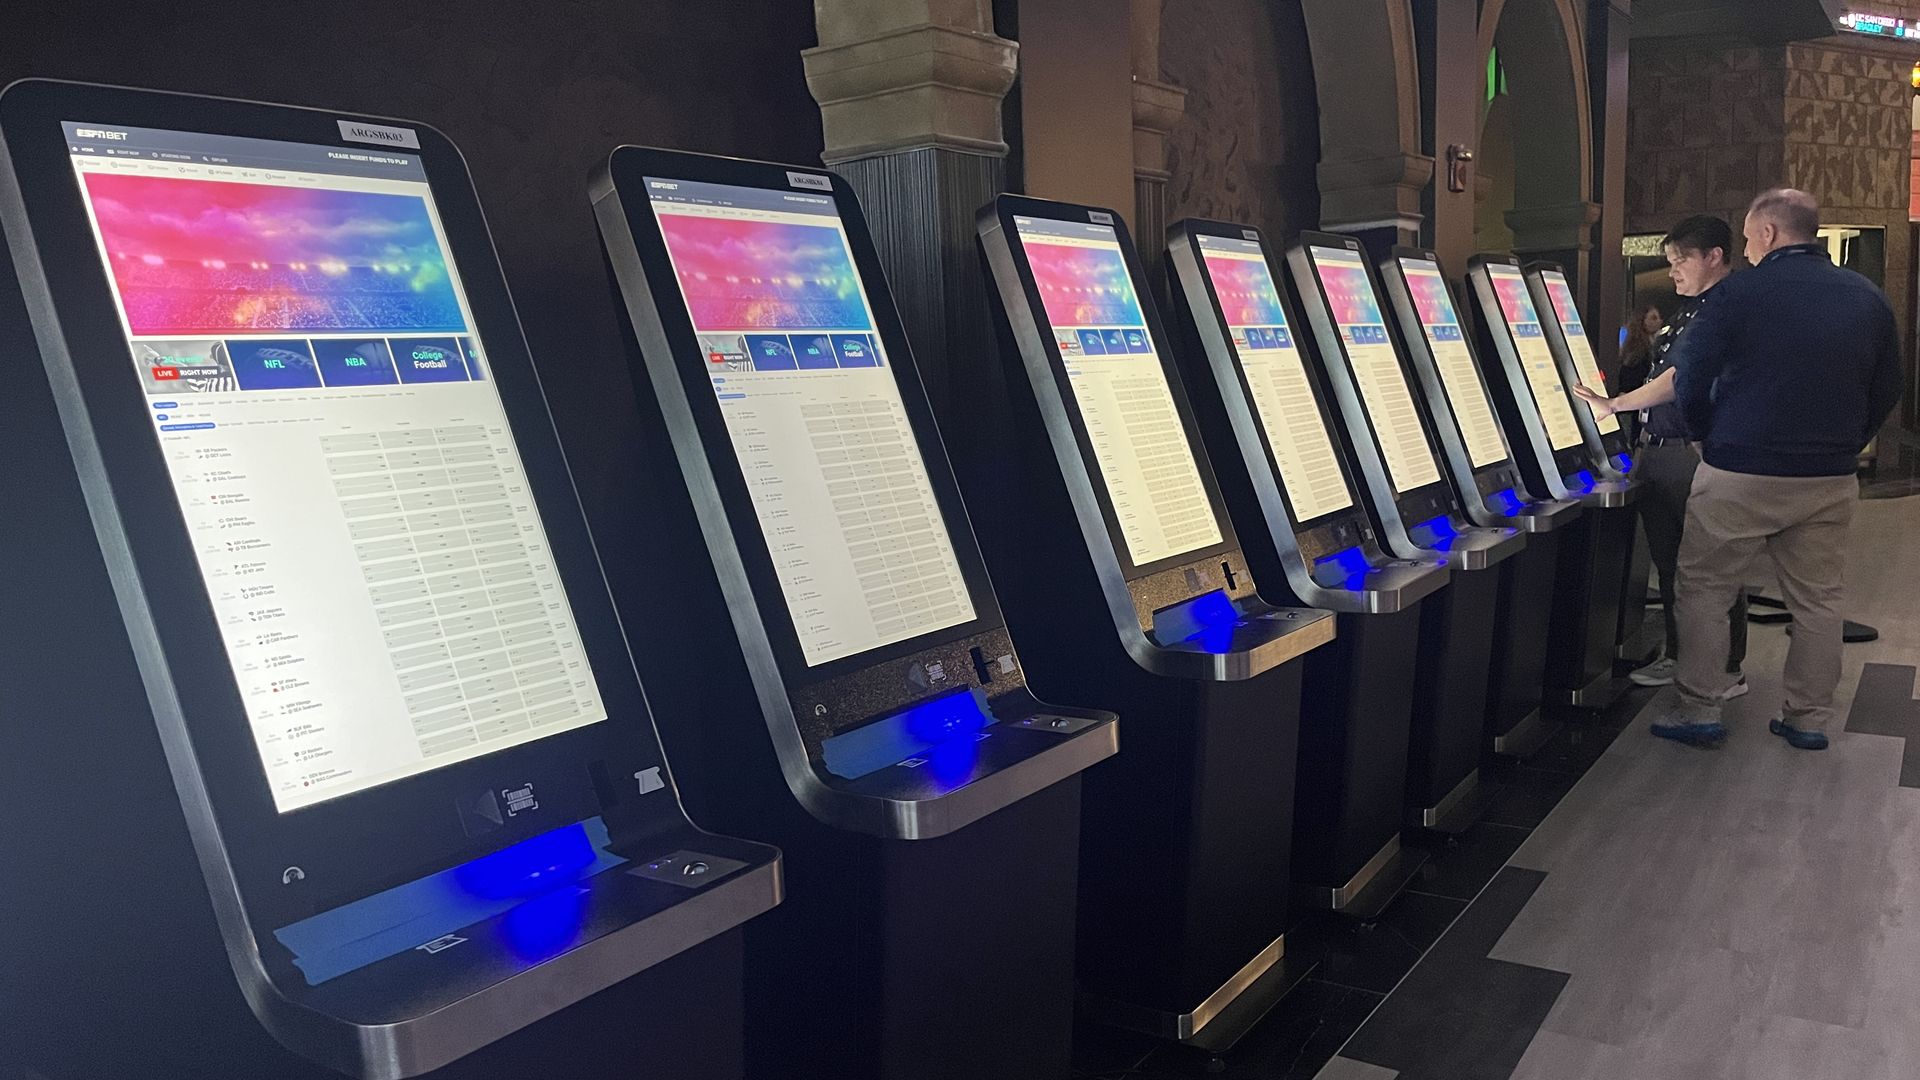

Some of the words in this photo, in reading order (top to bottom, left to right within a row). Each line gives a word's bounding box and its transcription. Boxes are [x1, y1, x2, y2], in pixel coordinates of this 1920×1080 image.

[106, 131, 128, 140] BET
[412, 351, 443, 360] College
[844, 350, 864, 358] Football
[264, 360, 285, 368] NFL
[345, 358, 366, 366] NBA
[414, 360, 447, 368] Football
